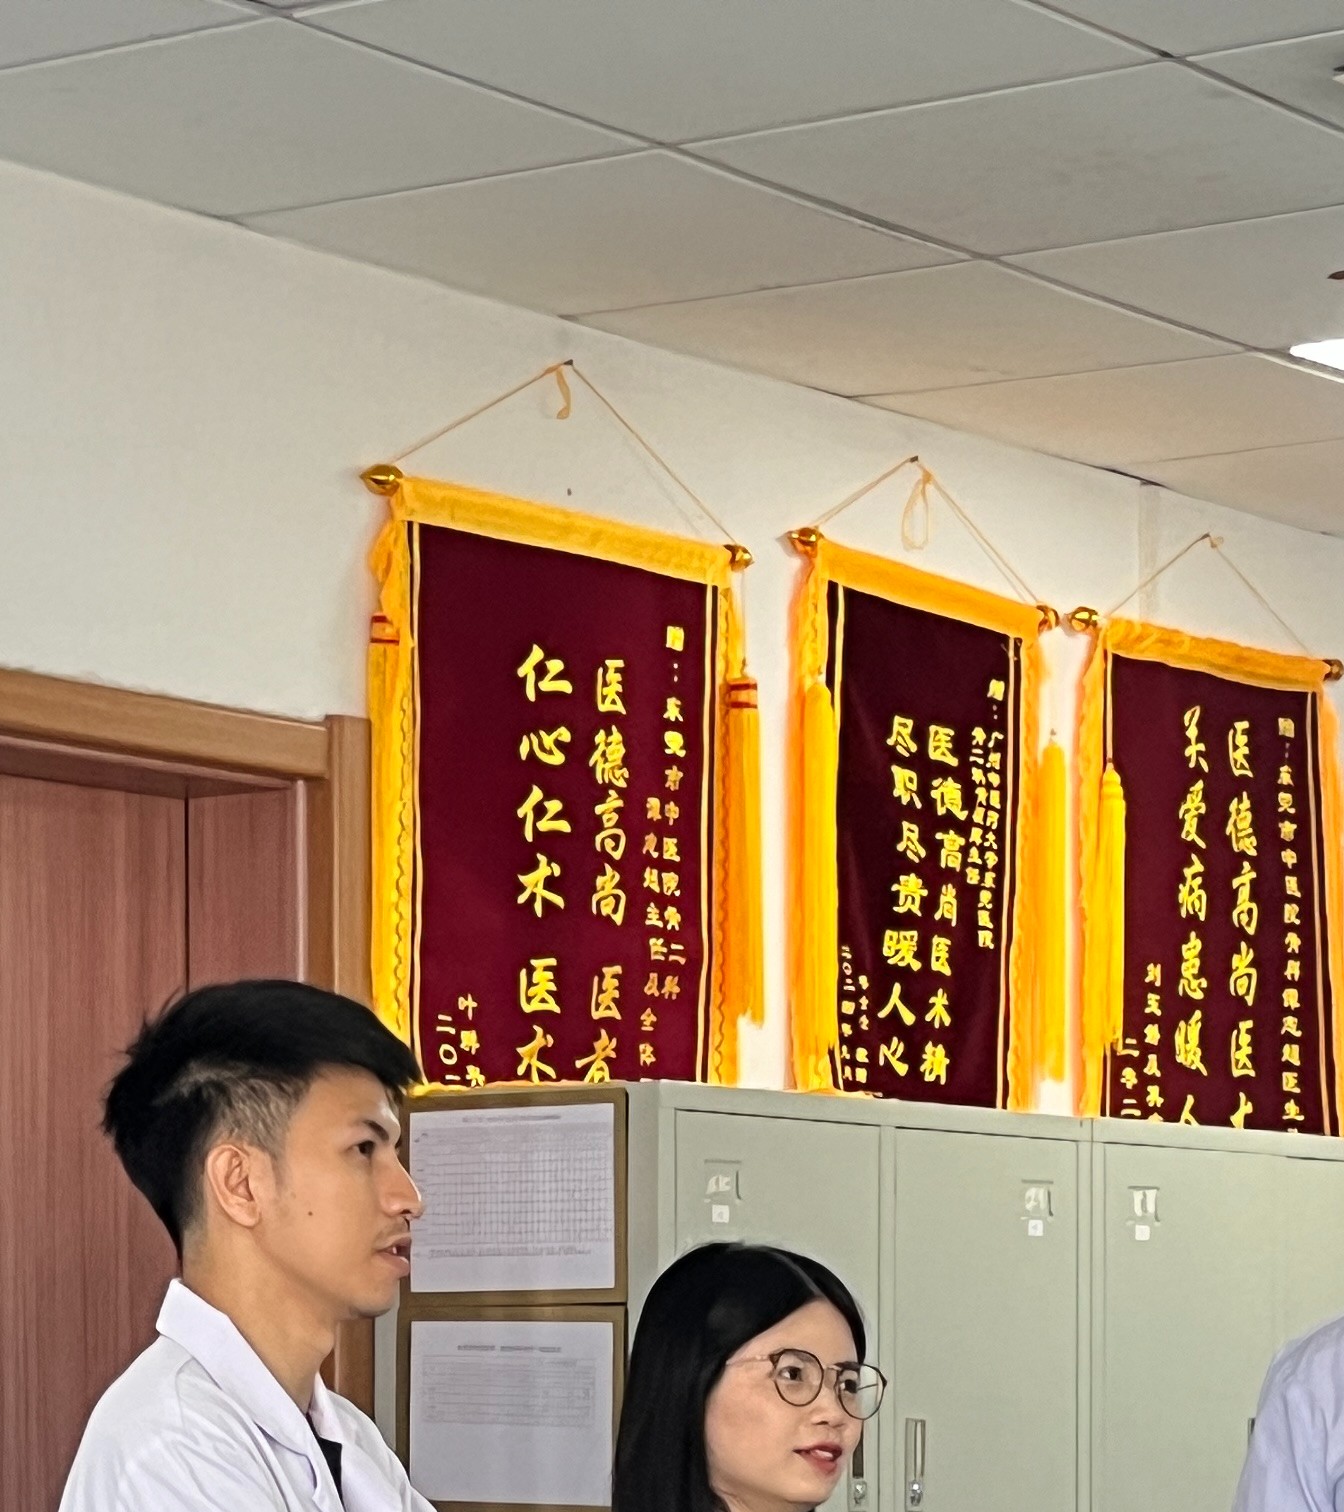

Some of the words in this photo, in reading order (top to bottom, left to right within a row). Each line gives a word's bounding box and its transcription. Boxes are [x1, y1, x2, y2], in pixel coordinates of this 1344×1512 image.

[516, 643, 573, 918] 仁心仁术
[588, 659, 630, 926] 医德高尚
